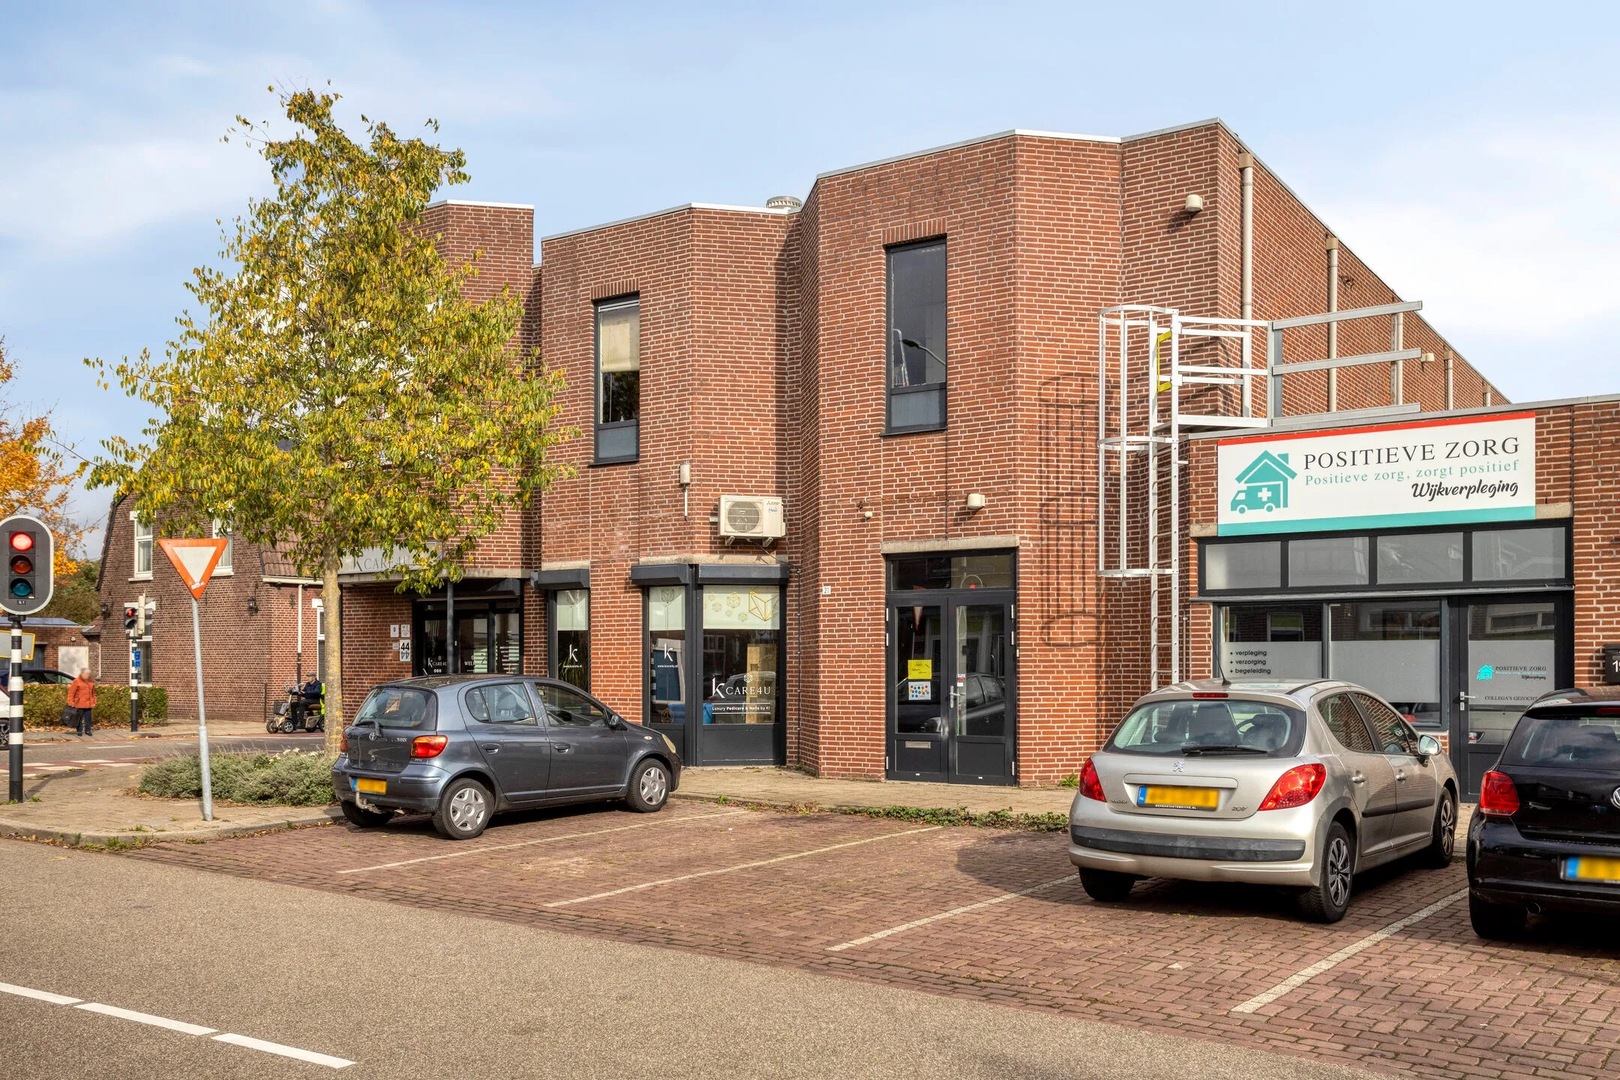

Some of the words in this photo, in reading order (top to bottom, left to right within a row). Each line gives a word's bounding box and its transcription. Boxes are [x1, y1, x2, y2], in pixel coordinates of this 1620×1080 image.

[1304, 443, 1435, 470] POSITIEVE
[1445, 436, 1520, 460] ZORG
[1305, 472, 1368, 486] Positieve
[1374, 470, 1410, 482] zorg,
[1416, 466, 1453, 480] zorgt
[1460, 459, 1519, 477] positief
[1411, 479, 1519, 502] Wijkverpleging
[400, 642, 410, 651] 44
[1612, 660, 1620, 673] 1
